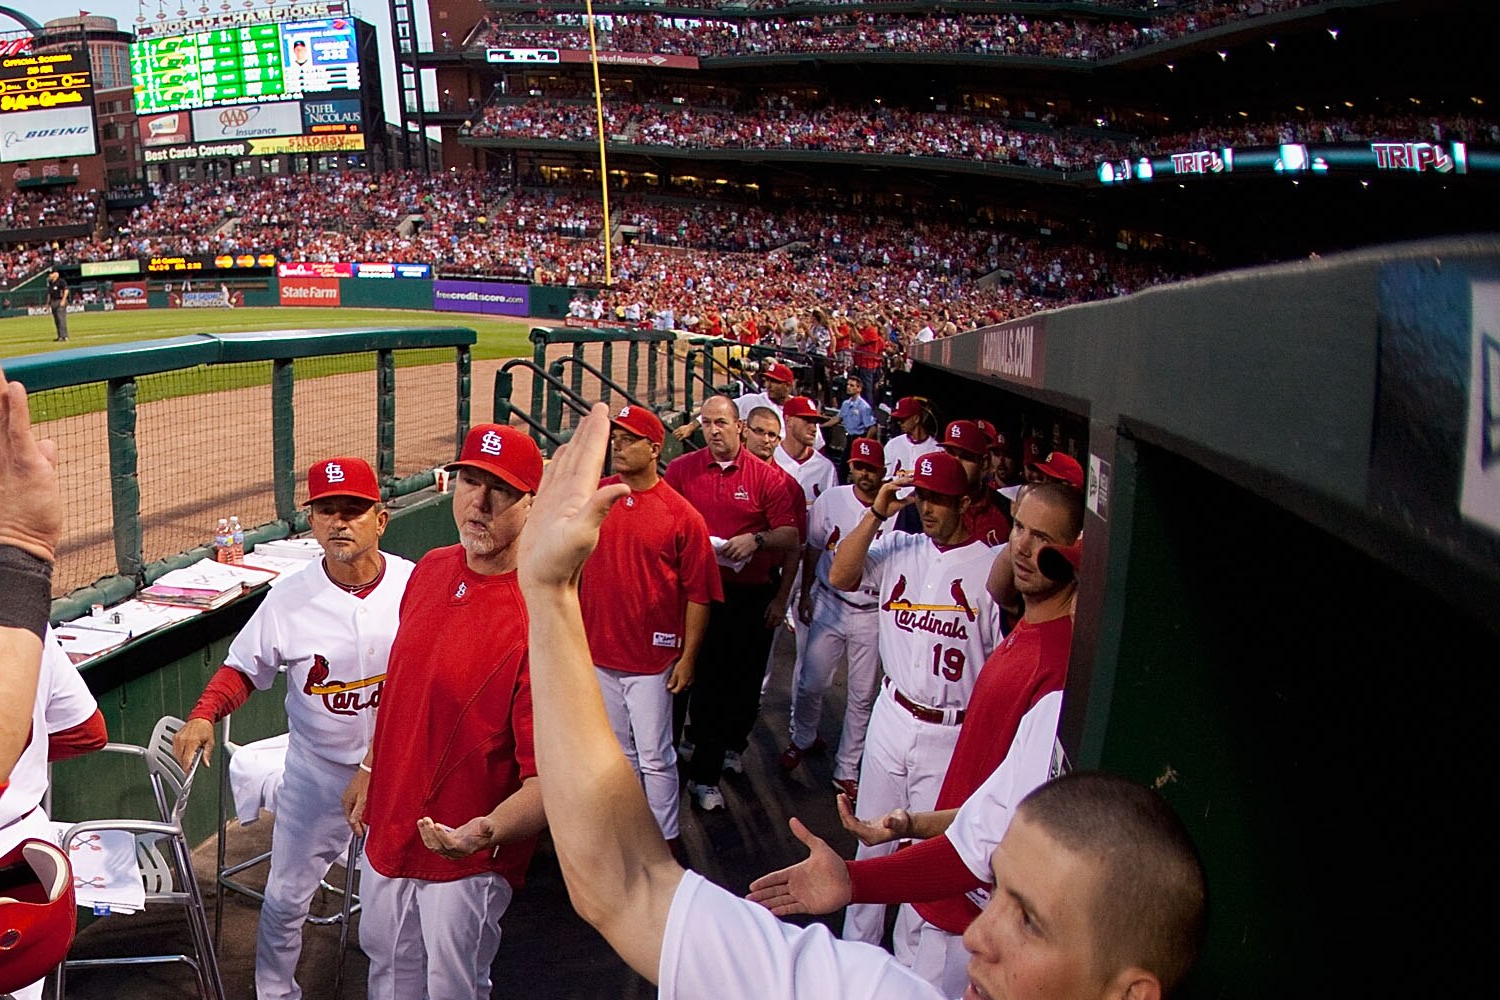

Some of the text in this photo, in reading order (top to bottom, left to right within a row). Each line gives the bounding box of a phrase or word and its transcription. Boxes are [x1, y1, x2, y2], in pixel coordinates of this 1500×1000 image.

[152, 17, 215, 34] WORLD
[220, 4, 328, 26] CHAMPIONS
[618, 55, 648, 64] America
[304, 103, 335, 114] STIFEL
[221, 110, 246, 127] AAA
[310, 111, 361, 123] NICOLAUS
[24, 125, 89, 140] BOEING
[236, 126, 277, 136] Insurance
[145, 144, 245, 162] Best Cards Coverage
[28, 306, 51, 316] BUSC
[982, 325, 1034, 378] CARDINALS.COM
[894, 606, 969, 640] Cardinals
[932, 643, 966, 683] 19
